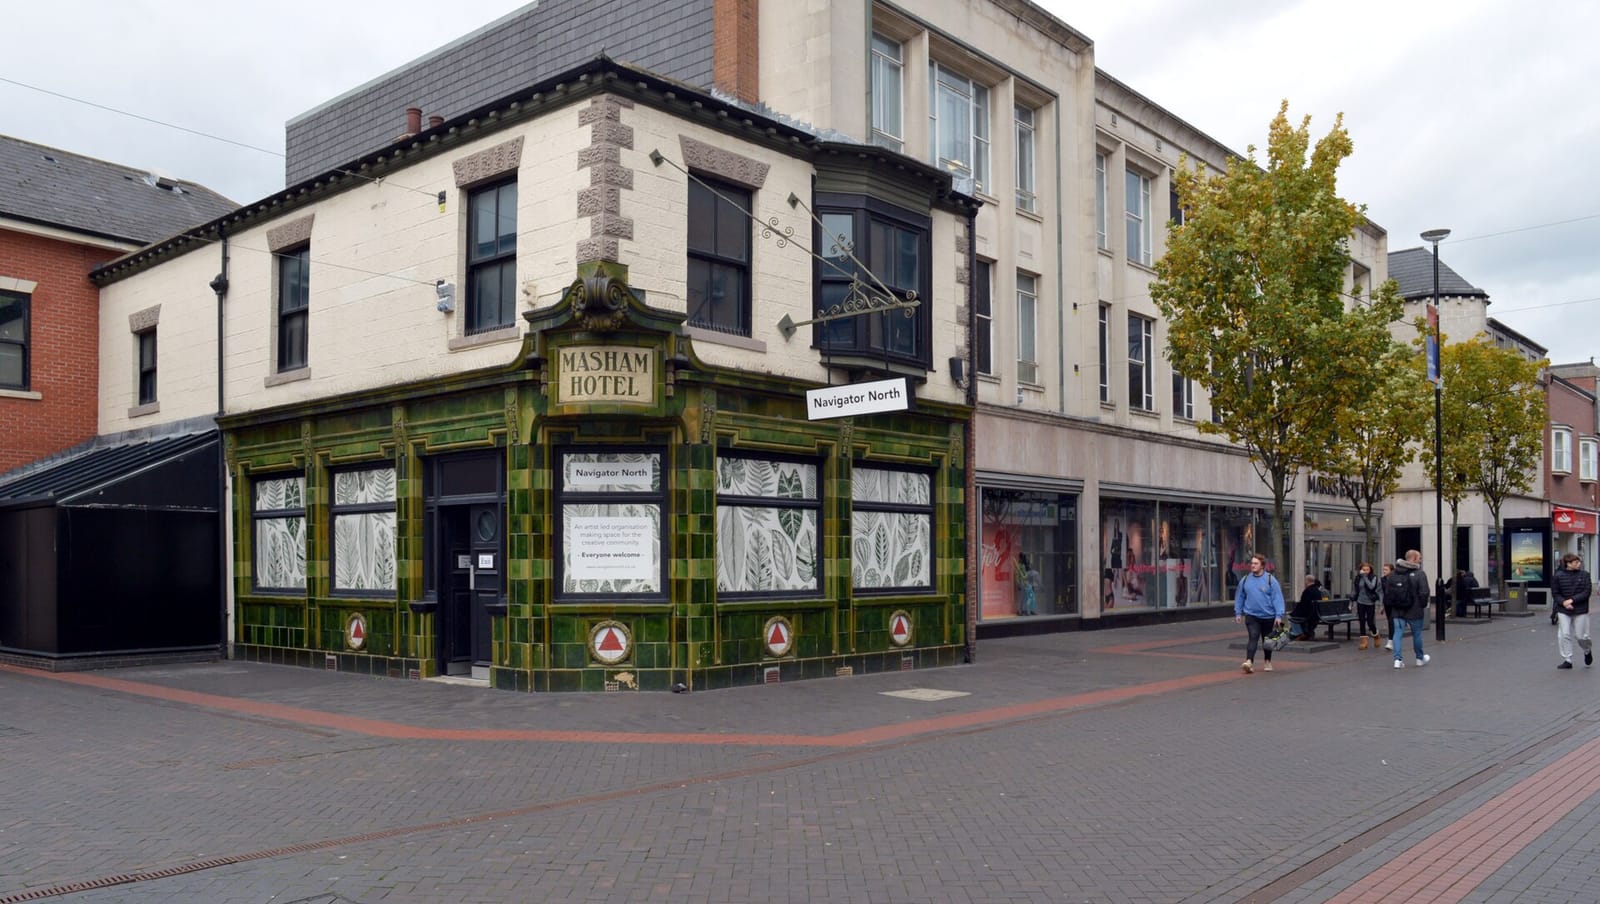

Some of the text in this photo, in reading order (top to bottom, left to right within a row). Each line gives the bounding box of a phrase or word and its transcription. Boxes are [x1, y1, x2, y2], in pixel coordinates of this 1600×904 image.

[562, 351, 648, 373] MASHAM
[570, 375, 639, 396] HOTEL
[813, 387, 900, 408] Navigator North
[575, 468, 648, 478] Navigator North
